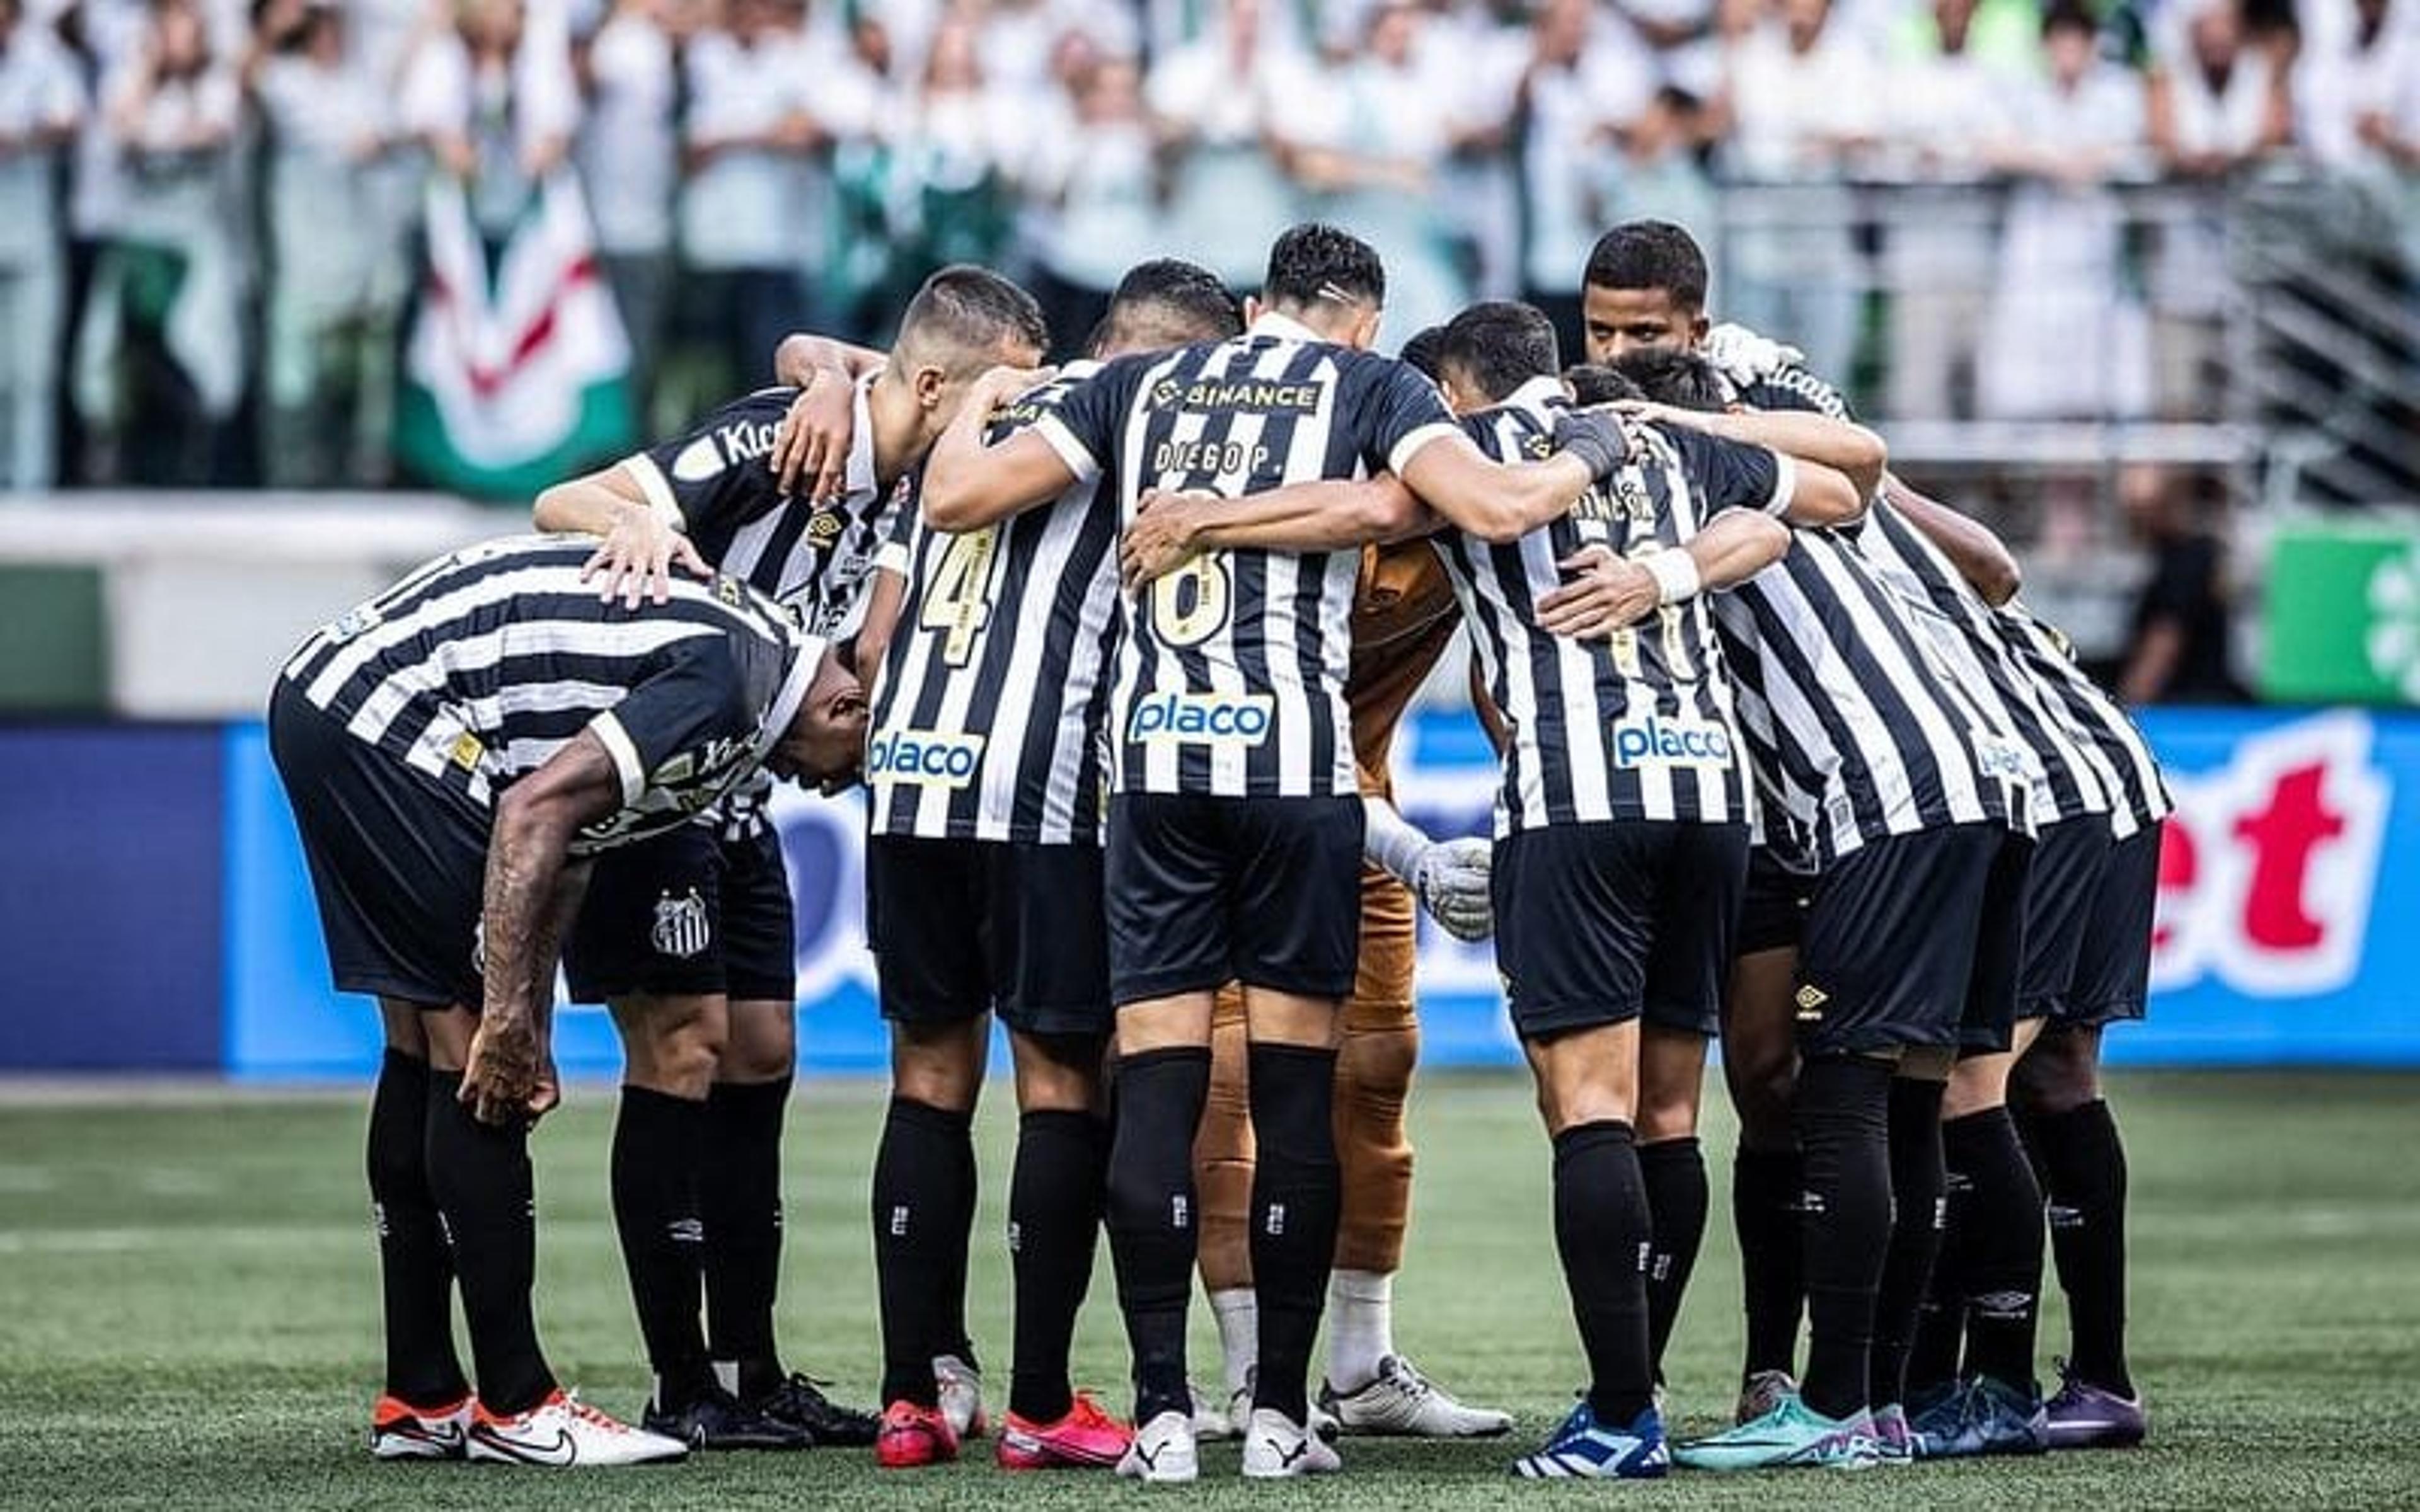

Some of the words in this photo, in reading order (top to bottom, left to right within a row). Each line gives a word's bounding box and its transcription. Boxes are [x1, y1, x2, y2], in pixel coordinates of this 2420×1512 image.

[1186, 383, 1317, 406] BINANCE
[1154, 442, 1243, 474] DIEGO
[1250, 444, 1283, 476] P.
[919, 524, 1003, 668] 4
[1134, 694, 1265, 739] placo
[1618, 716, 1728, 765] placo
